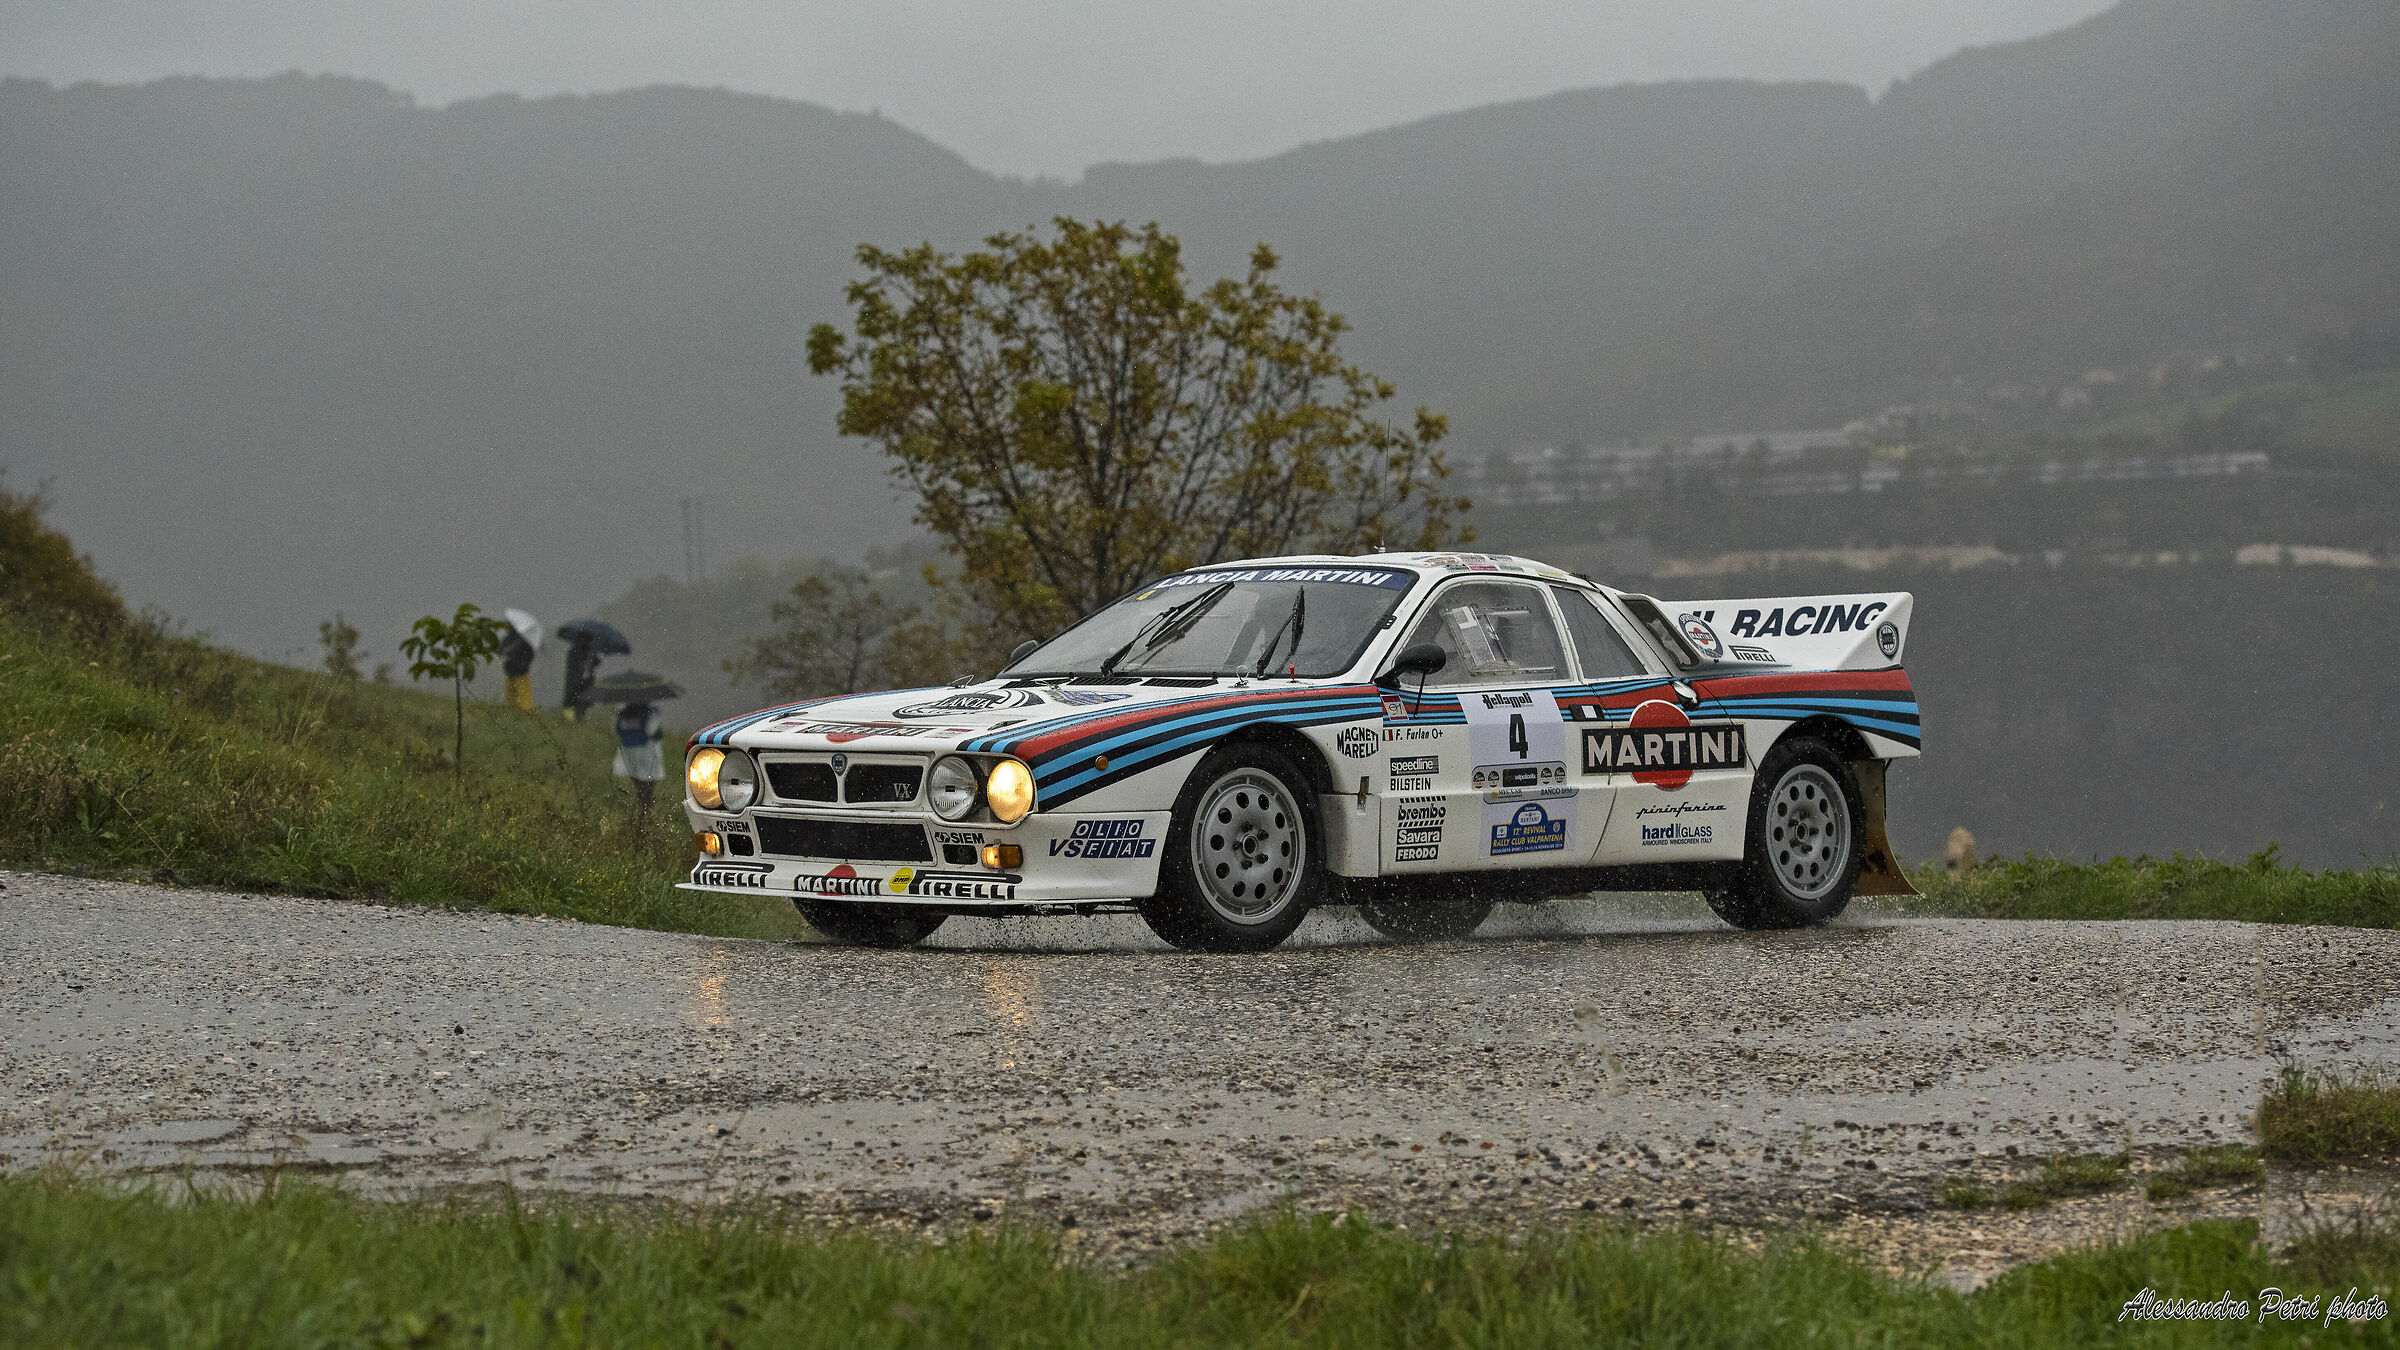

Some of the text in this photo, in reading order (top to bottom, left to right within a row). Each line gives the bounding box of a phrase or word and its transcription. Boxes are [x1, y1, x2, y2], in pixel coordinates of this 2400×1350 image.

[1153, 569, 1393, 590] LANCIA MARTINI
[1729, 601, 1888, 639] RACING
[1728, 645, 1777, 662] PIRELLI
[938, 697, 994, 708] LANCIA
[1481, 691, 1534, 710] Bellamoli
[1336, 726, 1379, 744] MAGNETI
[1395, 728, 1403, 741] F.
[1406, 727, 1430, 740] Furlan
[1509, 713, 1529, 760] 4
[1336, 740, 1379, 759] MARELLI
[1587, 731, 1739, 768] MARTINI
[1391, 757, 1434, 775] speedline
[893, 782, 911, 799] VX
[1389, 777, 1432, 791] BILSTEIN
[1397, 802, 1447, 821] brembo
[1635, 801, 1727, 820] pininfarina
[727, 820, 751, 833] SIEM
[1074, 822, 1141, 838] OLIO
[1523, 825, 1546, 835] REVIVAL
[951, 832, 985, 844] SIEM
[1397, 829, 1441, 844] Savara
[1492, 839, 1511, 848] RALLY
[1511, 837, 1526, 846] CLUB
[1641, 839, 1669, 847] ARMOURED
[1669, 838, 1700, 846] WINDSCREEN
[1085, 841, 1152, 856] FIAT
[1396, 846, 1438, 860] FERODO
[693, 861, 775, 888] PIRELLI
[797, 875, 881, 896] MARTINI
[908, 869, 1023, 900] PIRELLI
